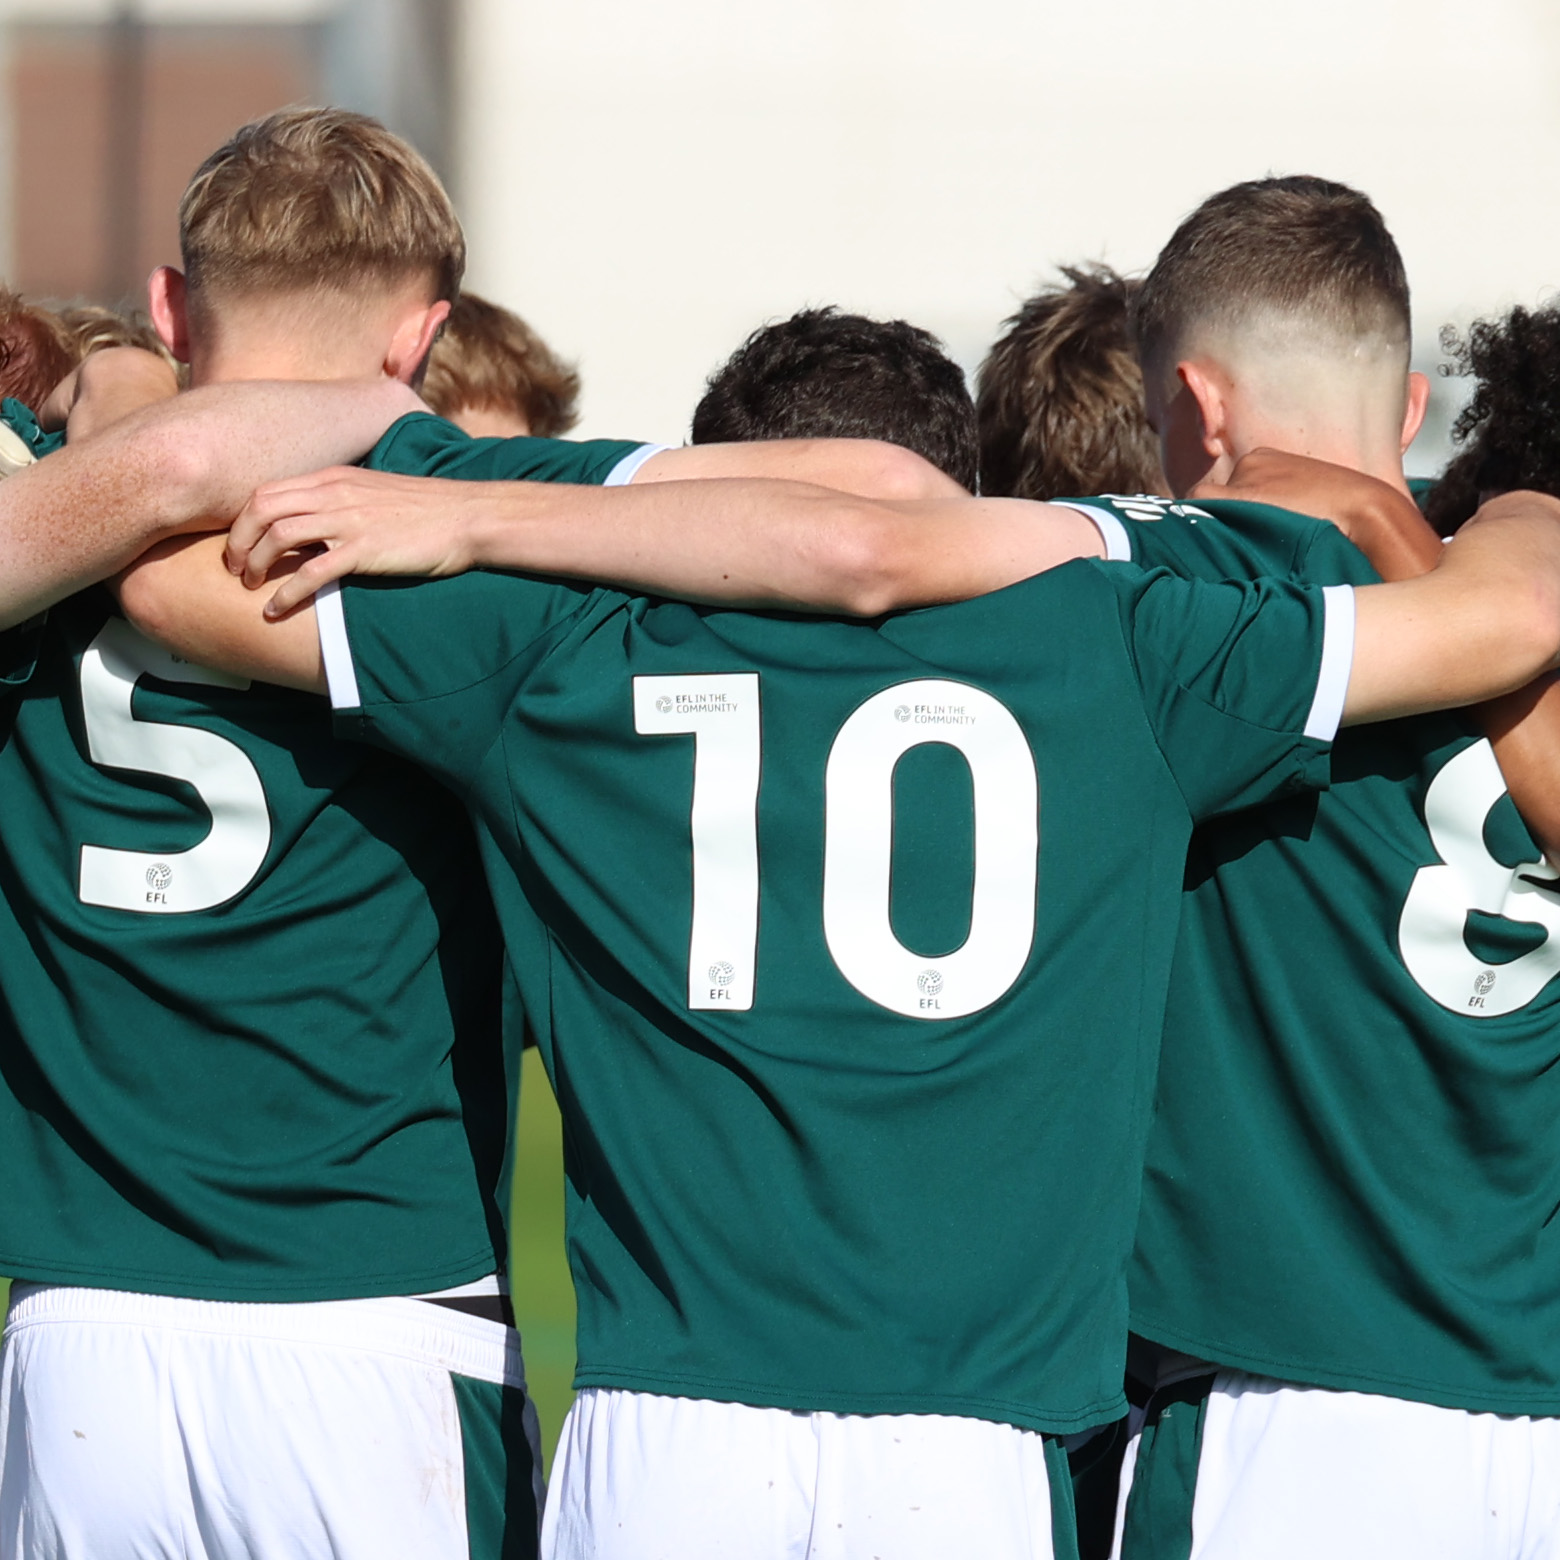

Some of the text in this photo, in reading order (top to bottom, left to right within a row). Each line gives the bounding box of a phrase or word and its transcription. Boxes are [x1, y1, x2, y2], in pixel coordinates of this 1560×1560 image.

[676, 693, 727, 703] EFL IN THE
[676, 703, 738, 714] COMMUNITY
[914, 704, 966, 715] EFL IN THE
[914, 714, 977, 725] COMMUNITY
[79, 616, 273, 915] 5
[631, 670, 1040, 1022] 10
[145, 891, 168, 905] EFL
[709, 988, 732, 1000] EFL
[919, 998, 942, 1010] EFL
[1468, 996, 1485, 1008] EFL
